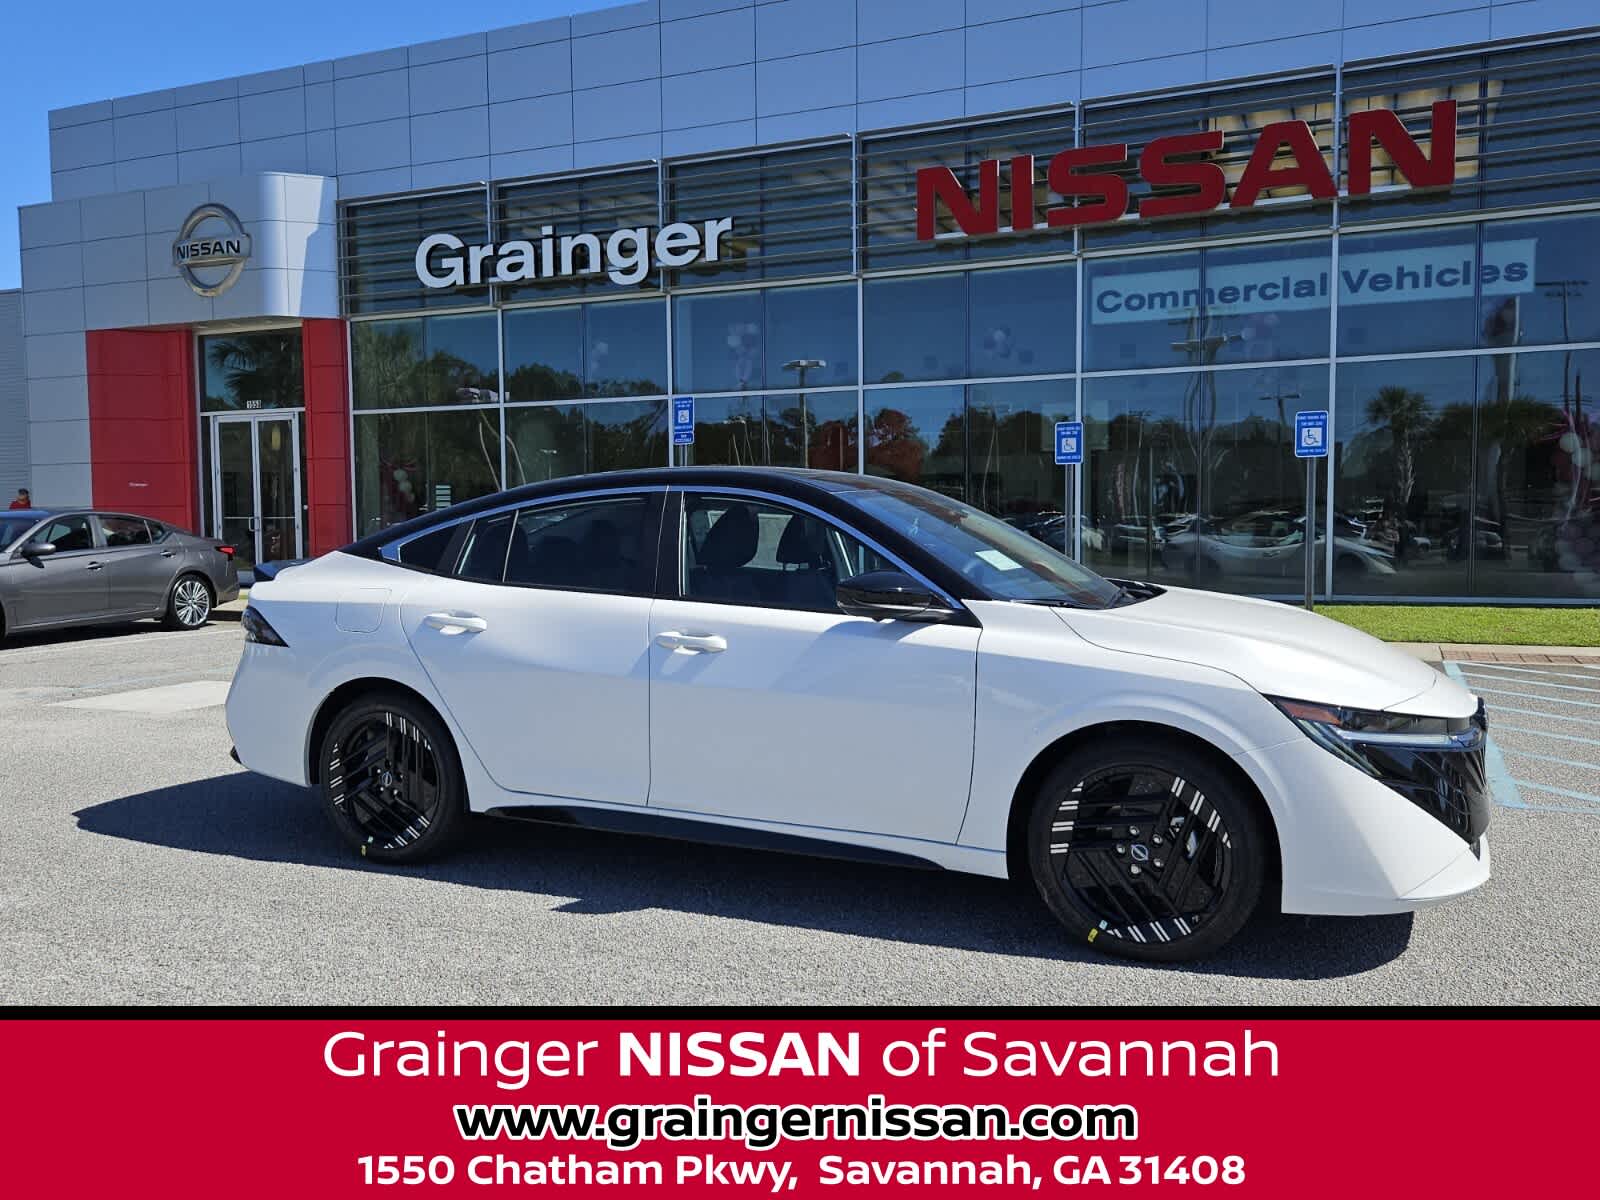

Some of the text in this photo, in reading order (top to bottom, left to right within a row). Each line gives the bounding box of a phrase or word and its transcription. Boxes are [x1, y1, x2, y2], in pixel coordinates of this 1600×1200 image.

[916, 99, 1457, 241] NISSAN
[176, 239, 241, 260] NISSAN
[415, 216, 734, 289] Grainger
[1096, 260, 1529, 314] Commercial Vehicles
